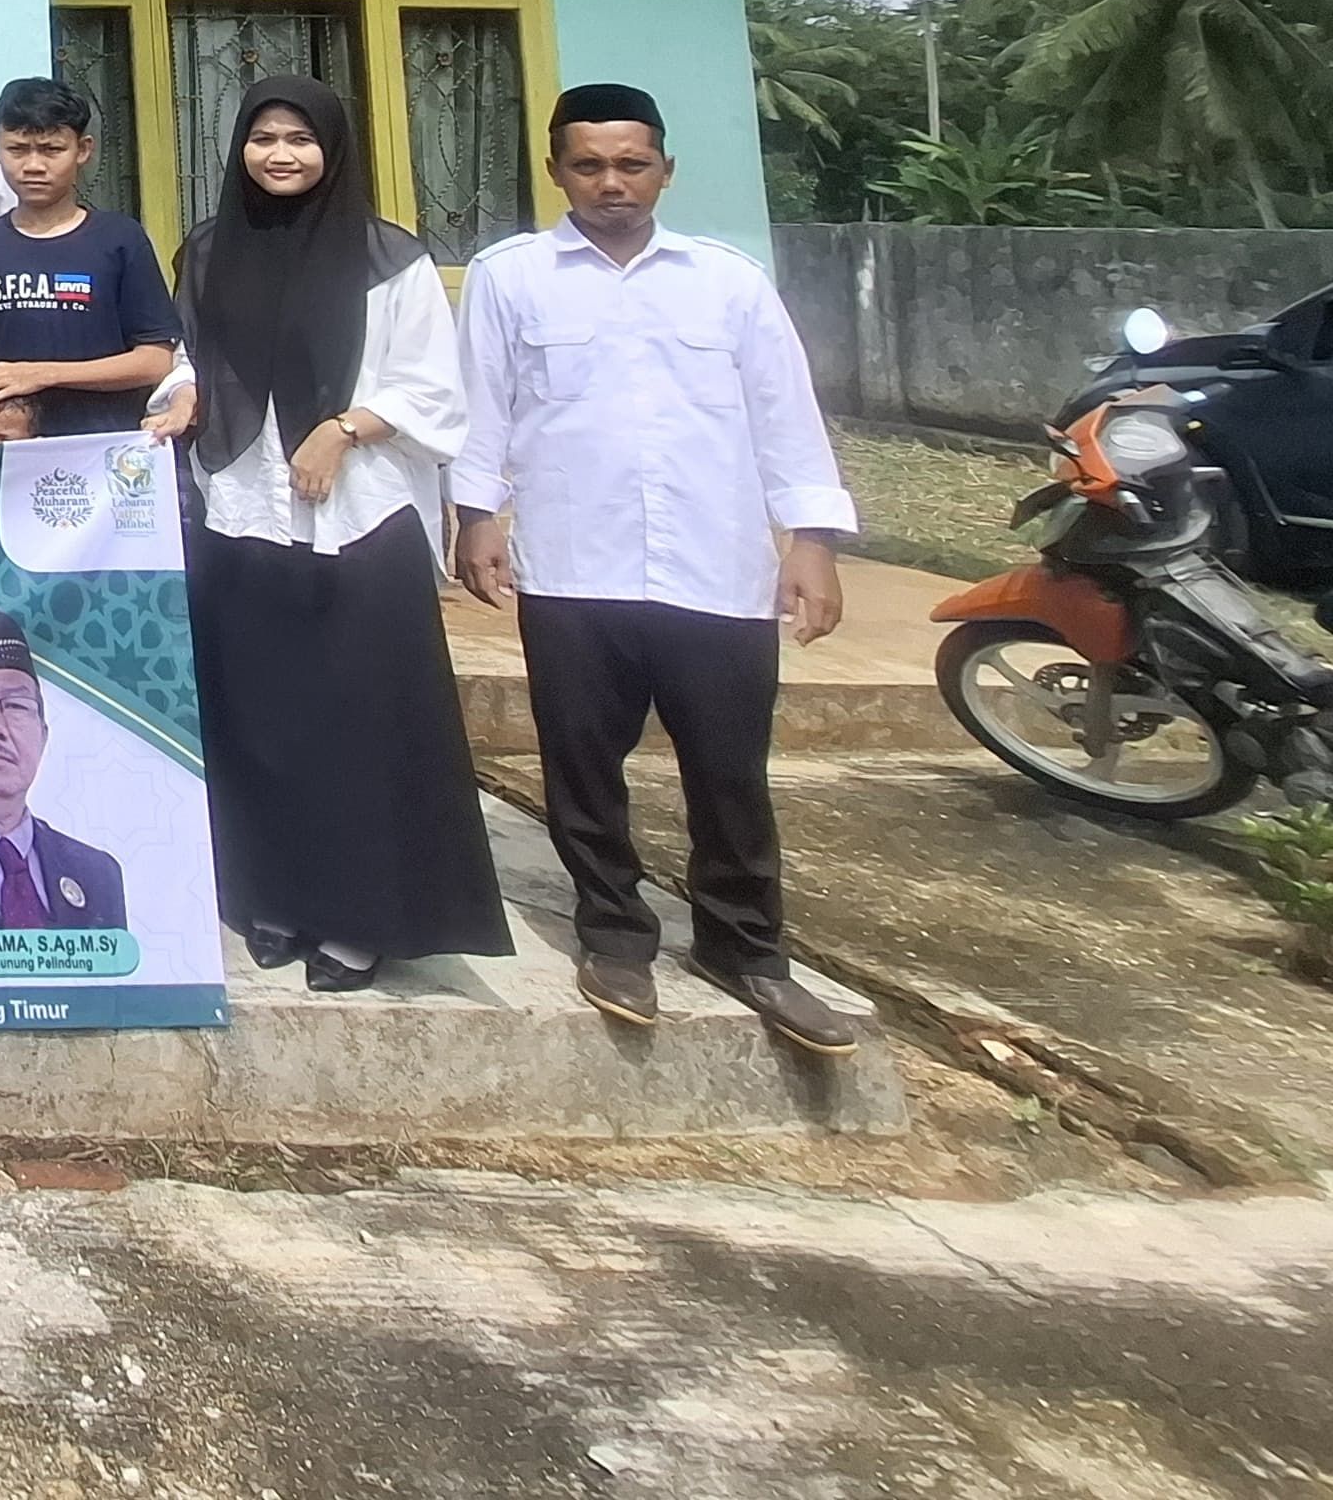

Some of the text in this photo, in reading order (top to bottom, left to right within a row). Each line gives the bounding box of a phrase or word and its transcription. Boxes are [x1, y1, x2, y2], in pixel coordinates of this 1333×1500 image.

[35, 485, 85, 496] Peaceful
[34, 496, 90, 507] Muharam
[112, 497, 155, 508] Lebaran
[116, 518, 155, 529] Difabel
[37, 935, 118, 956] S.Ag.M.Sy
[37, 956, 93, 972] Pelindung
[10, 999, 70, 1020] Timur
